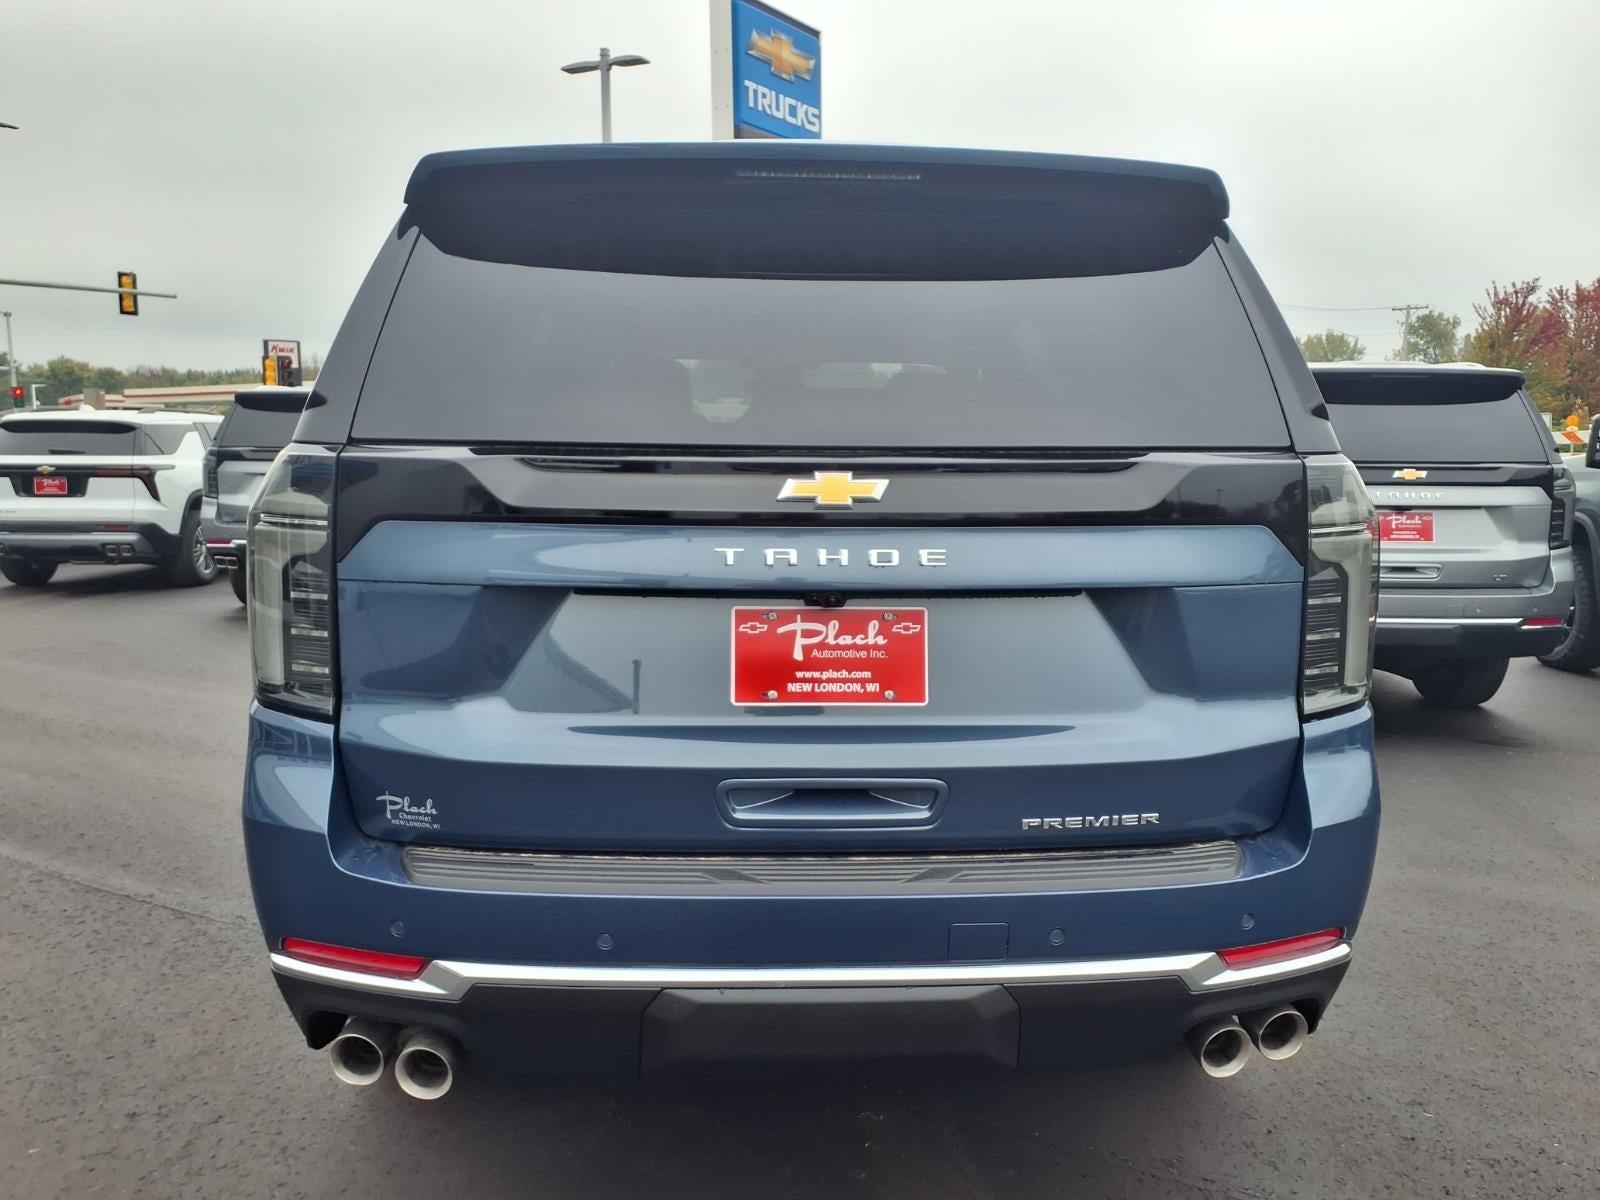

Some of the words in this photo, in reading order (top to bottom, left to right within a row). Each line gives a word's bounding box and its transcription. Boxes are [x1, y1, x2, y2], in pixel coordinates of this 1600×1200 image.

[744, 79, 820, 133] TRUCKS
[714, 548, 947, 566] TAHOE
[777, 614, 888, 661] Plach
[811, 649, 868, 658] Automotive
[869, 649, 889, 658] Inc.
[796, 669, 871, 680] www.plach.com
[787, 683, 813, 692] NEW
[815, 683, 864, 693] LONDON,
[866, 683, 880, 692] WI
[376, 790, 438, 819] Plach
[399, 812, 432, 822] Chevrolet
[1022, 813, 1160, 830] PREMIER
